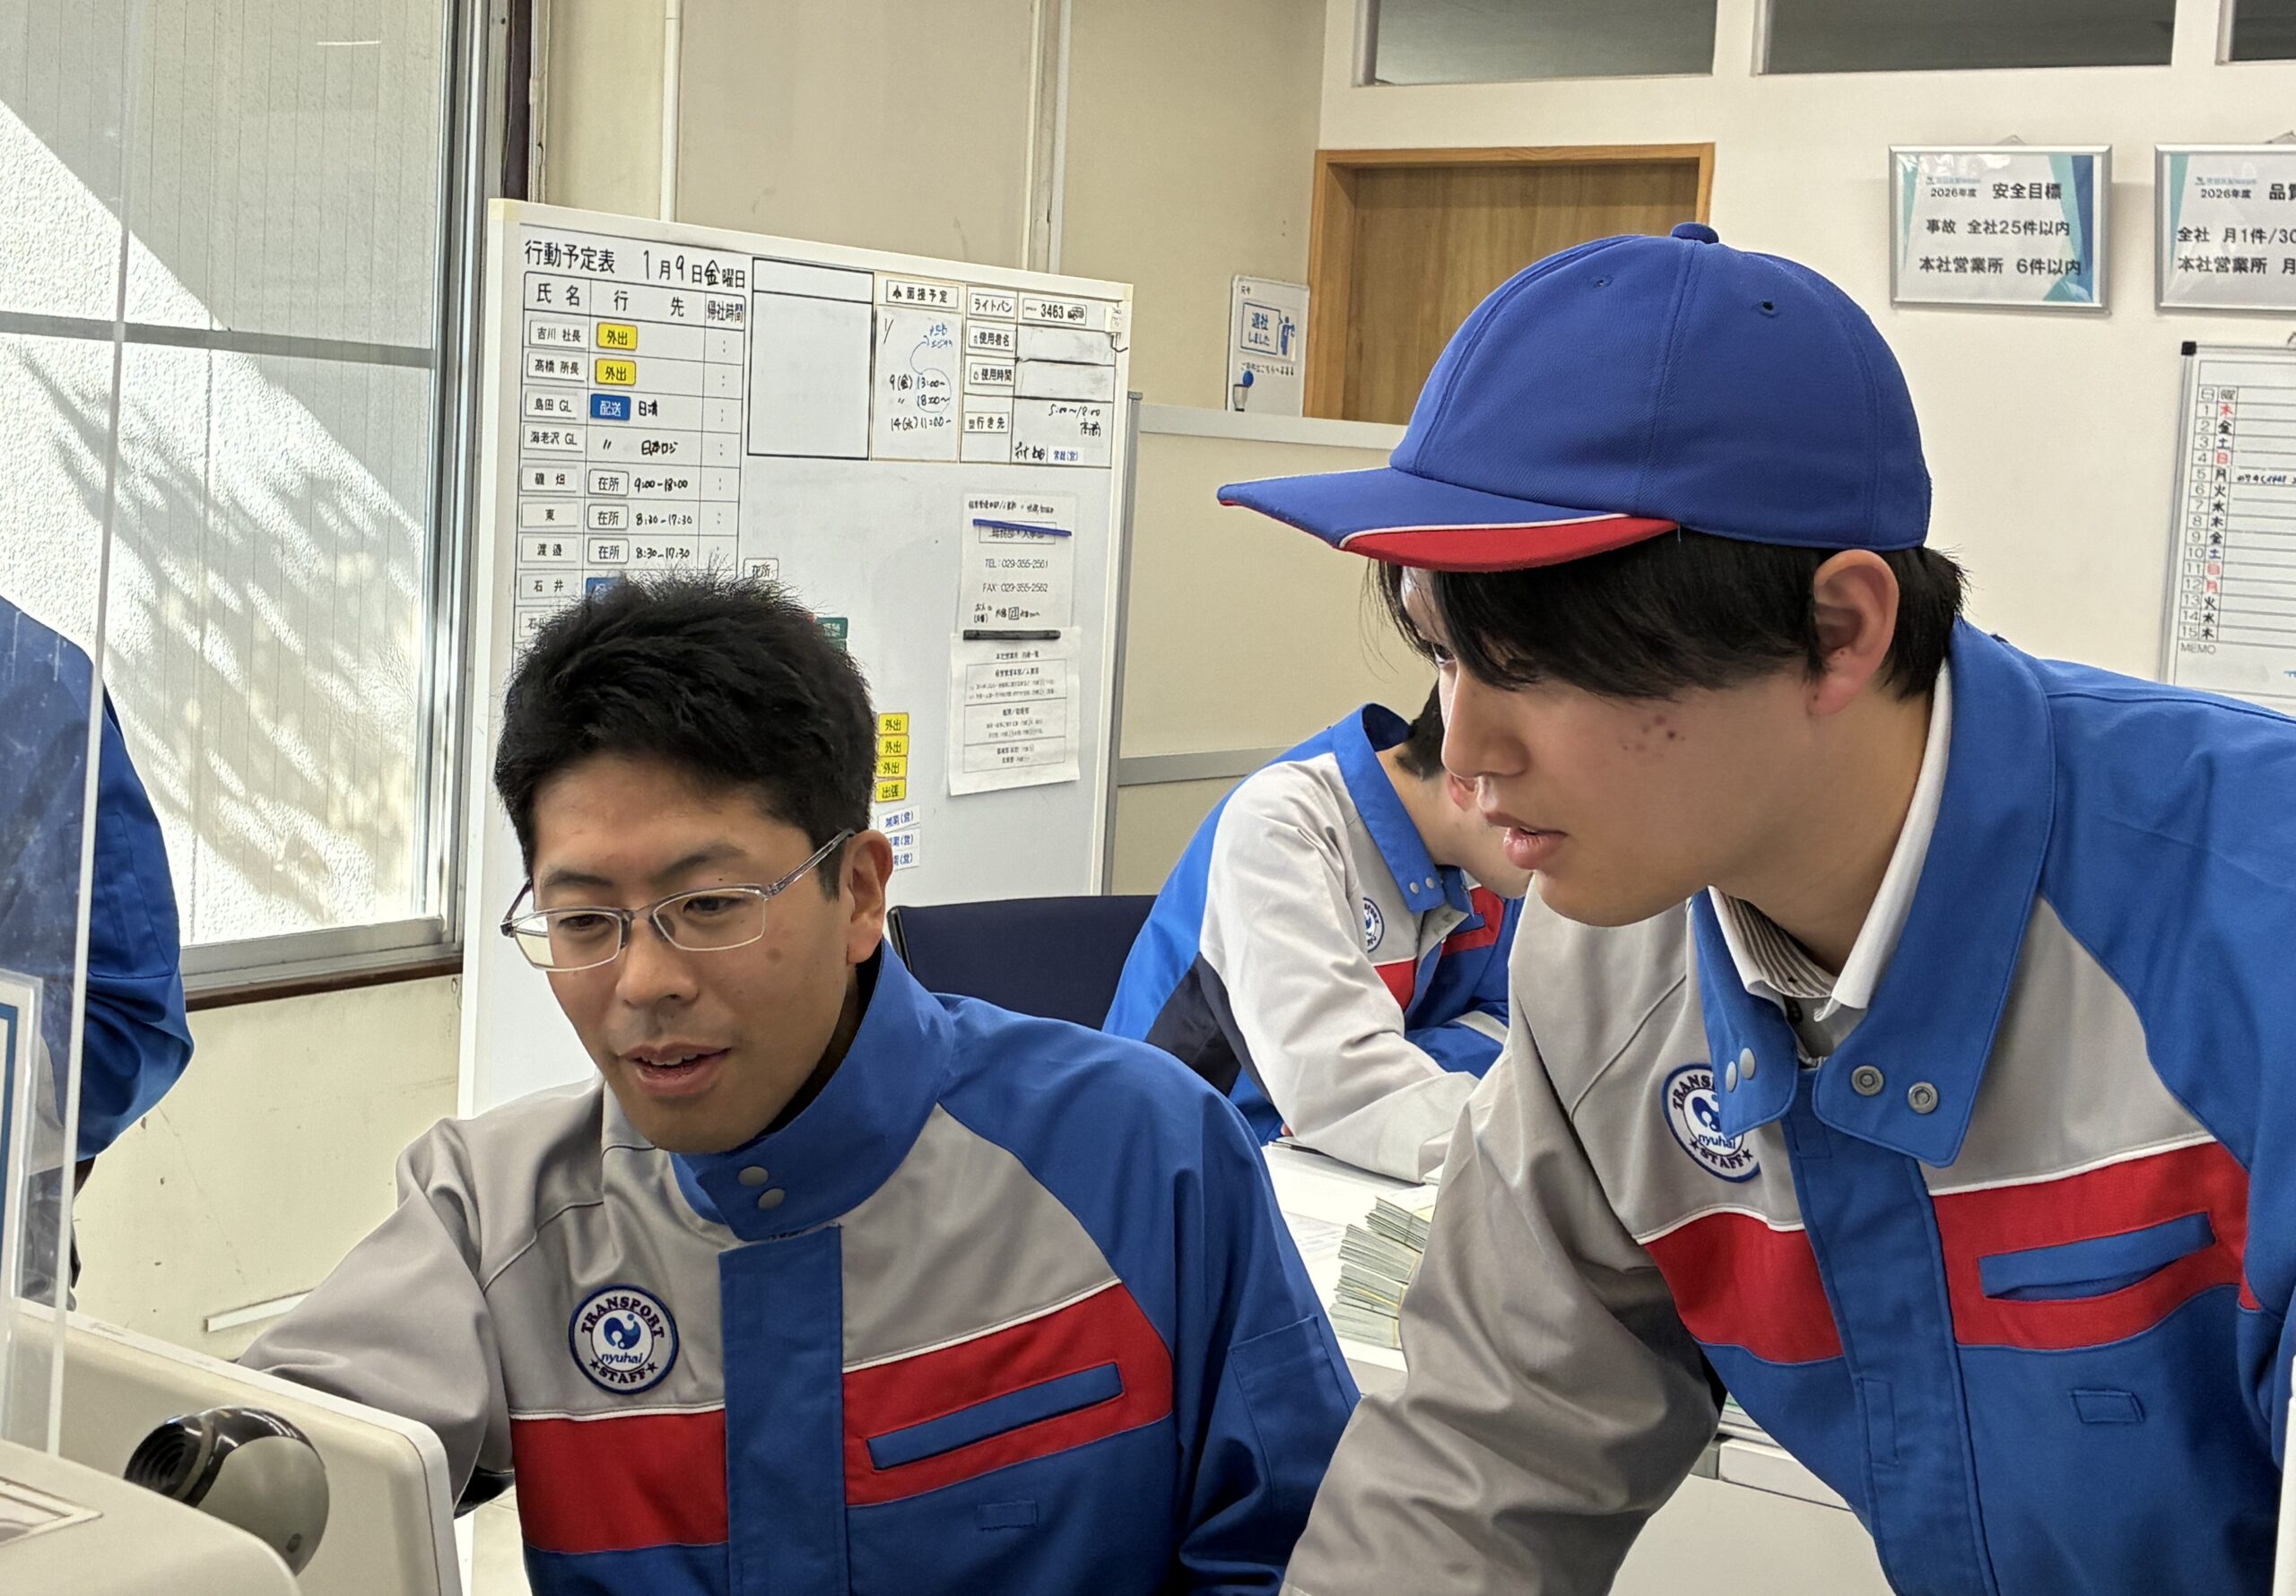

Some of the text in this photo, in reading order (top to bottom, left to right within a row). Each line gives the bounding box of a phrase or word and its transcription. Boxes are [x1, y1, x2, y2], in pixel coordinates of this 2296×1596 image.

[1931, 182, 2063, 200] 2026年度 安全目標
[2200, 188, 2252, 199] 2026年度
[1926, 219, 2071, 236] 事故 全社25件以内
[2177, 226, 2210, 243] 全社
[525, 239, 615, 274] 行動予定表
[1918, 256, 2082, 277] 本社営業所 6件以内
[2178, 256, 2267, 275] 本社営業所
[1040, 303, 1064, 319] 3463
[562, 328, 581, 343] 社長
[606, 329, 628, 346] 外出
[561, 360, 578, 376] 所長
[605, 365, 627, 381] 外出
[560, 399, 572, 413] GL
[599, 400, 621, 417] 配送
[2220, 403, 2234, 417] 木
[2200, 420, 2232, 436] 2 金
[530, 430, 578, 446] 海老沢 GL
[2199, 436, 2231, 450] 3 土
[2197, 451, 2229, 465] 4 日
[2196, 468, 2206, 480] 5
[2215, 468, 2227, 482] 月
[598, 476, 619, 491] 在所
[2195, 483, 2226, 499] 6 火
[2194, 499, 2225, 513] 7 水
[597, 510, 619, 525] 在所
[2192, 516, 2223, 528] 8 木
[2191, 531, 2222, 545] 9 金
[598, 544, 620, 559] 在所
[2188, 547, 2222, 559] 10 土
[2187, 562, 2201, 575] 11
[2186, 578, 2218, 594] 12 月
[2185, 594, 2217, 611] 13 火
[2183, 610, 2215, 624] 14 水
[2181, 626, 2214, 640] 15 木
[2181, 642, 2216, 655] MEMO
[884, 718, 901, 732] 外出
[884, 741, 901, 754] 外出
[883, 761, 900, 775] 外出
[882, 784, 899, 799] 出張
[1700, 1148, 1744, 1169] STAFF
[581, 1296, 665, 1339] TRANSPORT
[601, 1352, 643, 1365] nyuhai
[598, 1366, 647, 1384] STAFF
